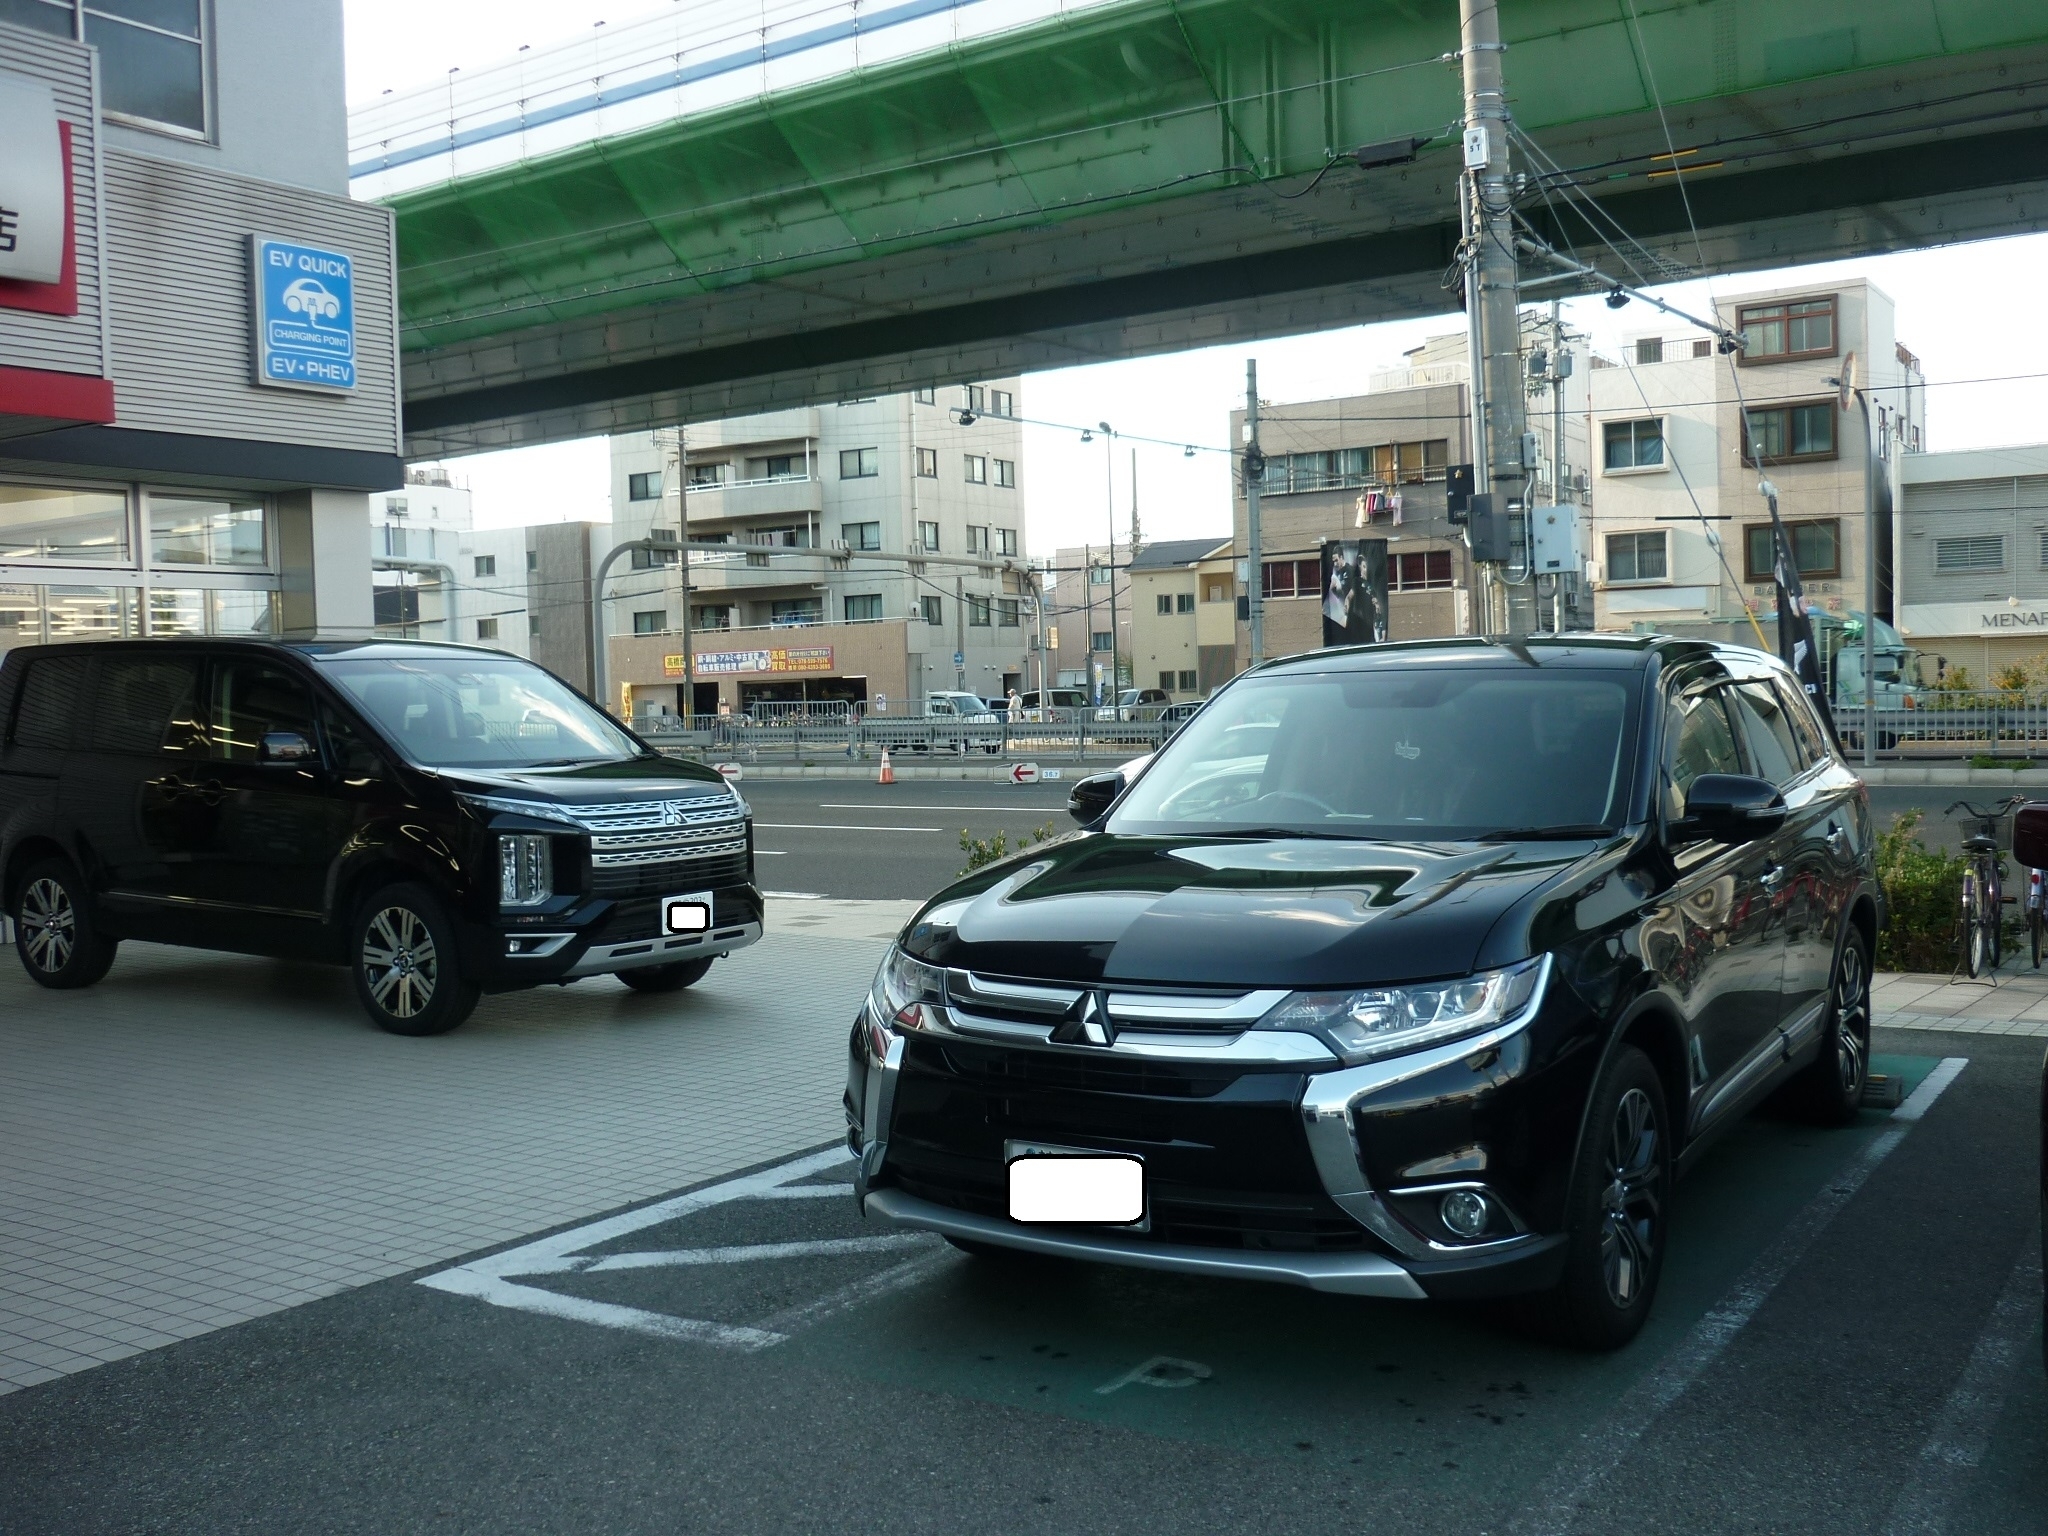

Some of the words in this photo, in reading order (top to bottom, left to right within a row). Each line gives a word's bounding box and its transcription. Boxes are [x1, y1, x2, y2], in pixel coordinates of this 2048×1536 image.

[270, 250, 293, 268] EV
[298, 254, 347, 278] QUICK
[274, 329, 321, 343] CHARGING
[323, 335, 347, 348] POINT
